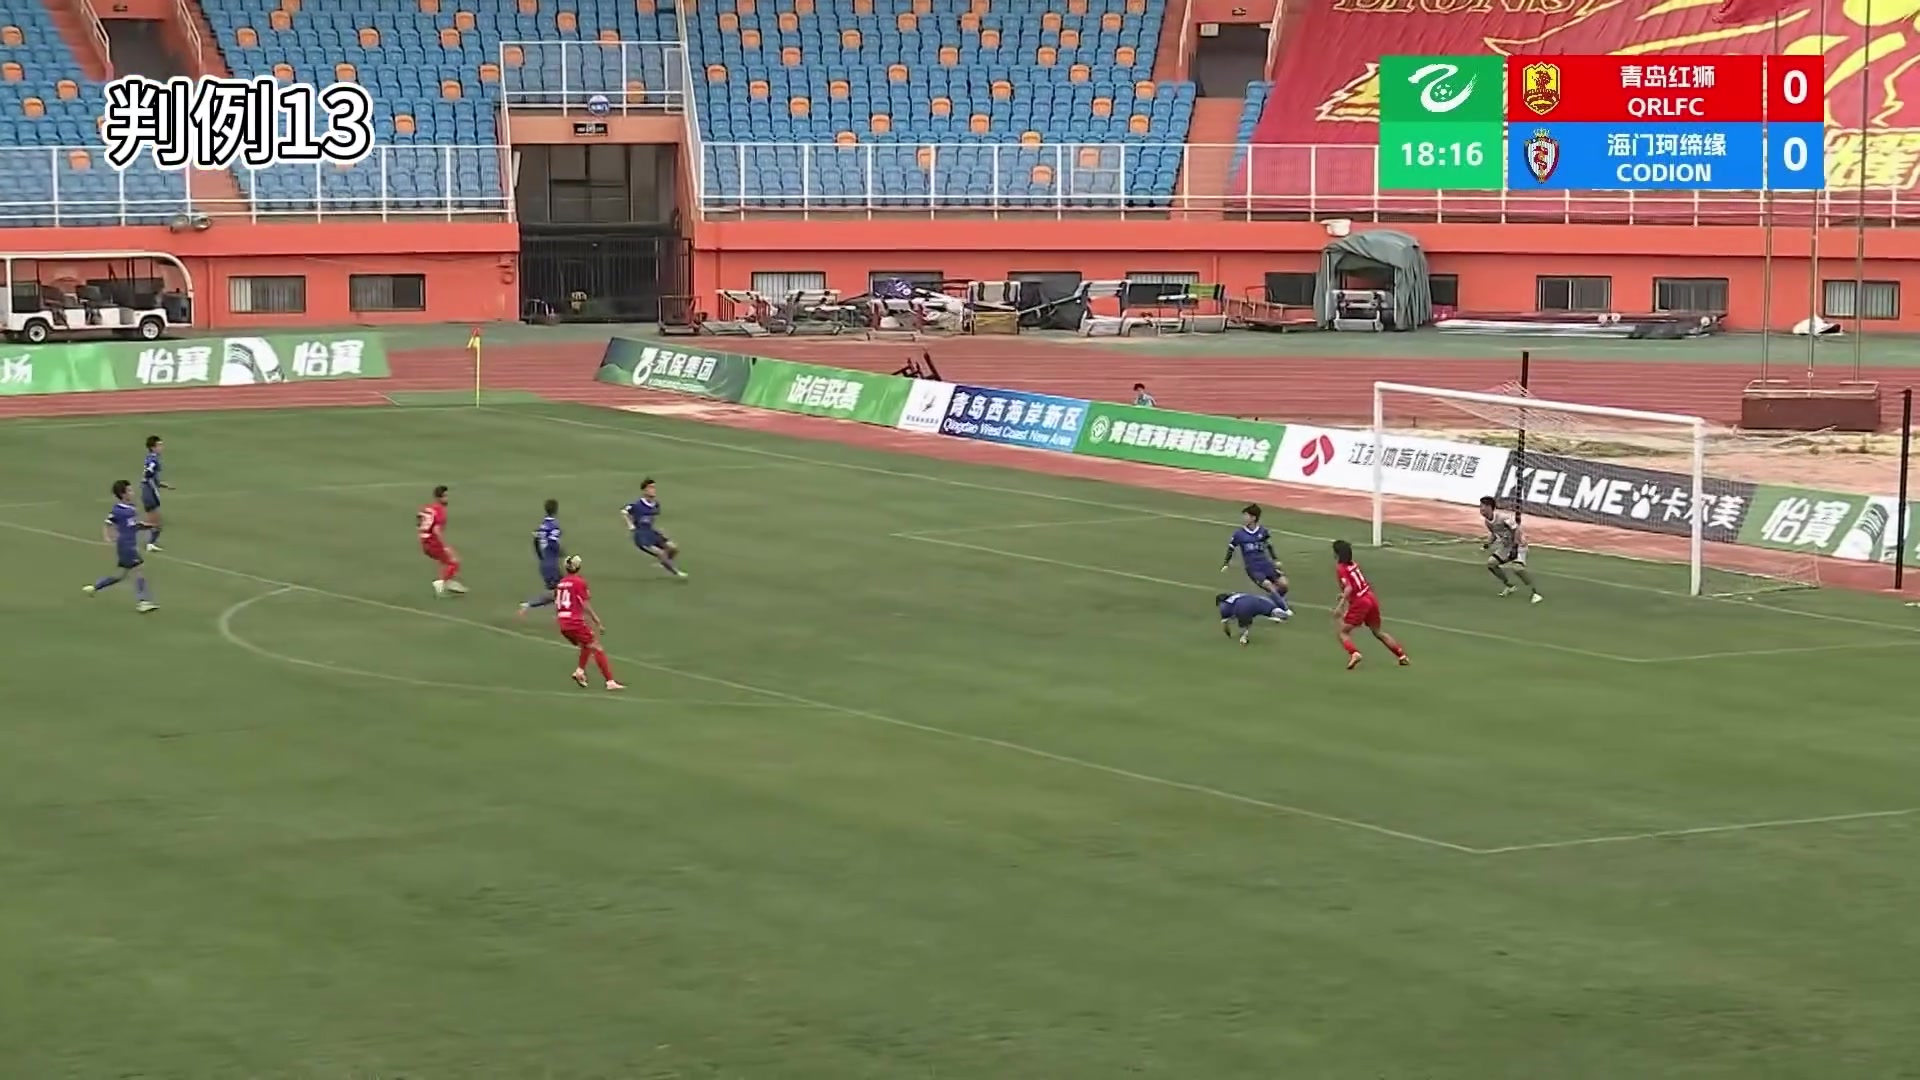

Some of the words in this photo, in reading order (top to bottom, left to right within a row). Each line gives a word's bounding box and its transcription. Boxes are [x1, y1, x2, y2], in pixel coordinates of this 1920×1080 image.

[786, 373, 864, 411] 诚信联赛
[948, 391, 1083, 431] 青岛西海岸新区
[943, 418, 978, 435] Qingdao
[980, 421, 1002, 437] West
[1002, 427, 1028, 440] Coast
[1030, 430, 1049, 443] New
[1049, 433, 1072, 447] Area
[1108, 420, 1271, 462] 青岛西海岸新区足球协会
[1501, 464, 1633, 515] KELME
[555, 588, 572, 610] 14
